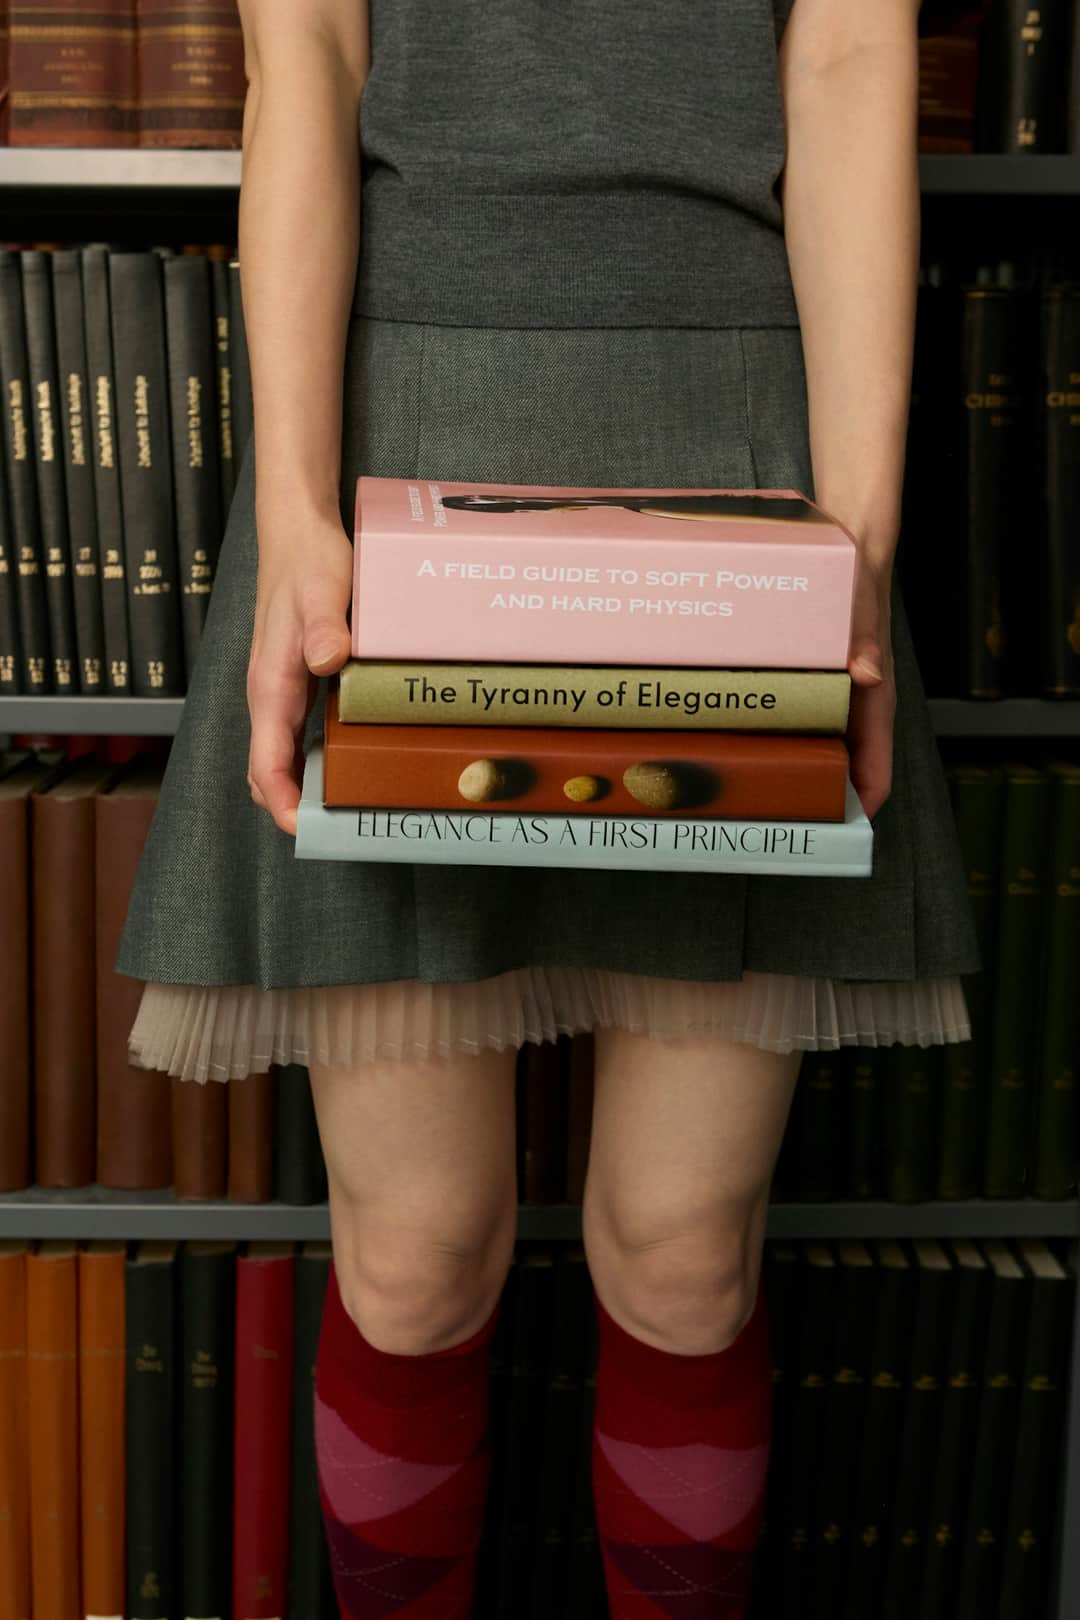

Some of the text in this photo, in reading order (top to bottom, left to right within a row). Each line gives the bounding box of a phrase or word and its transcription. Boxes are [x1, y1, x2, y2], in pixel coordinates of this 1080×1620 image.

[418, 560, 808, 592] A FIELD GUIDE TO SOFT POWER
[490, 593, 733, 617] AND HARD PHYSICS
[404, 677, 777, 716] The Tyranny of Elegance
[357, 811, 817, 855] ELEGANCE AS A FIRST PRINCIPLE
